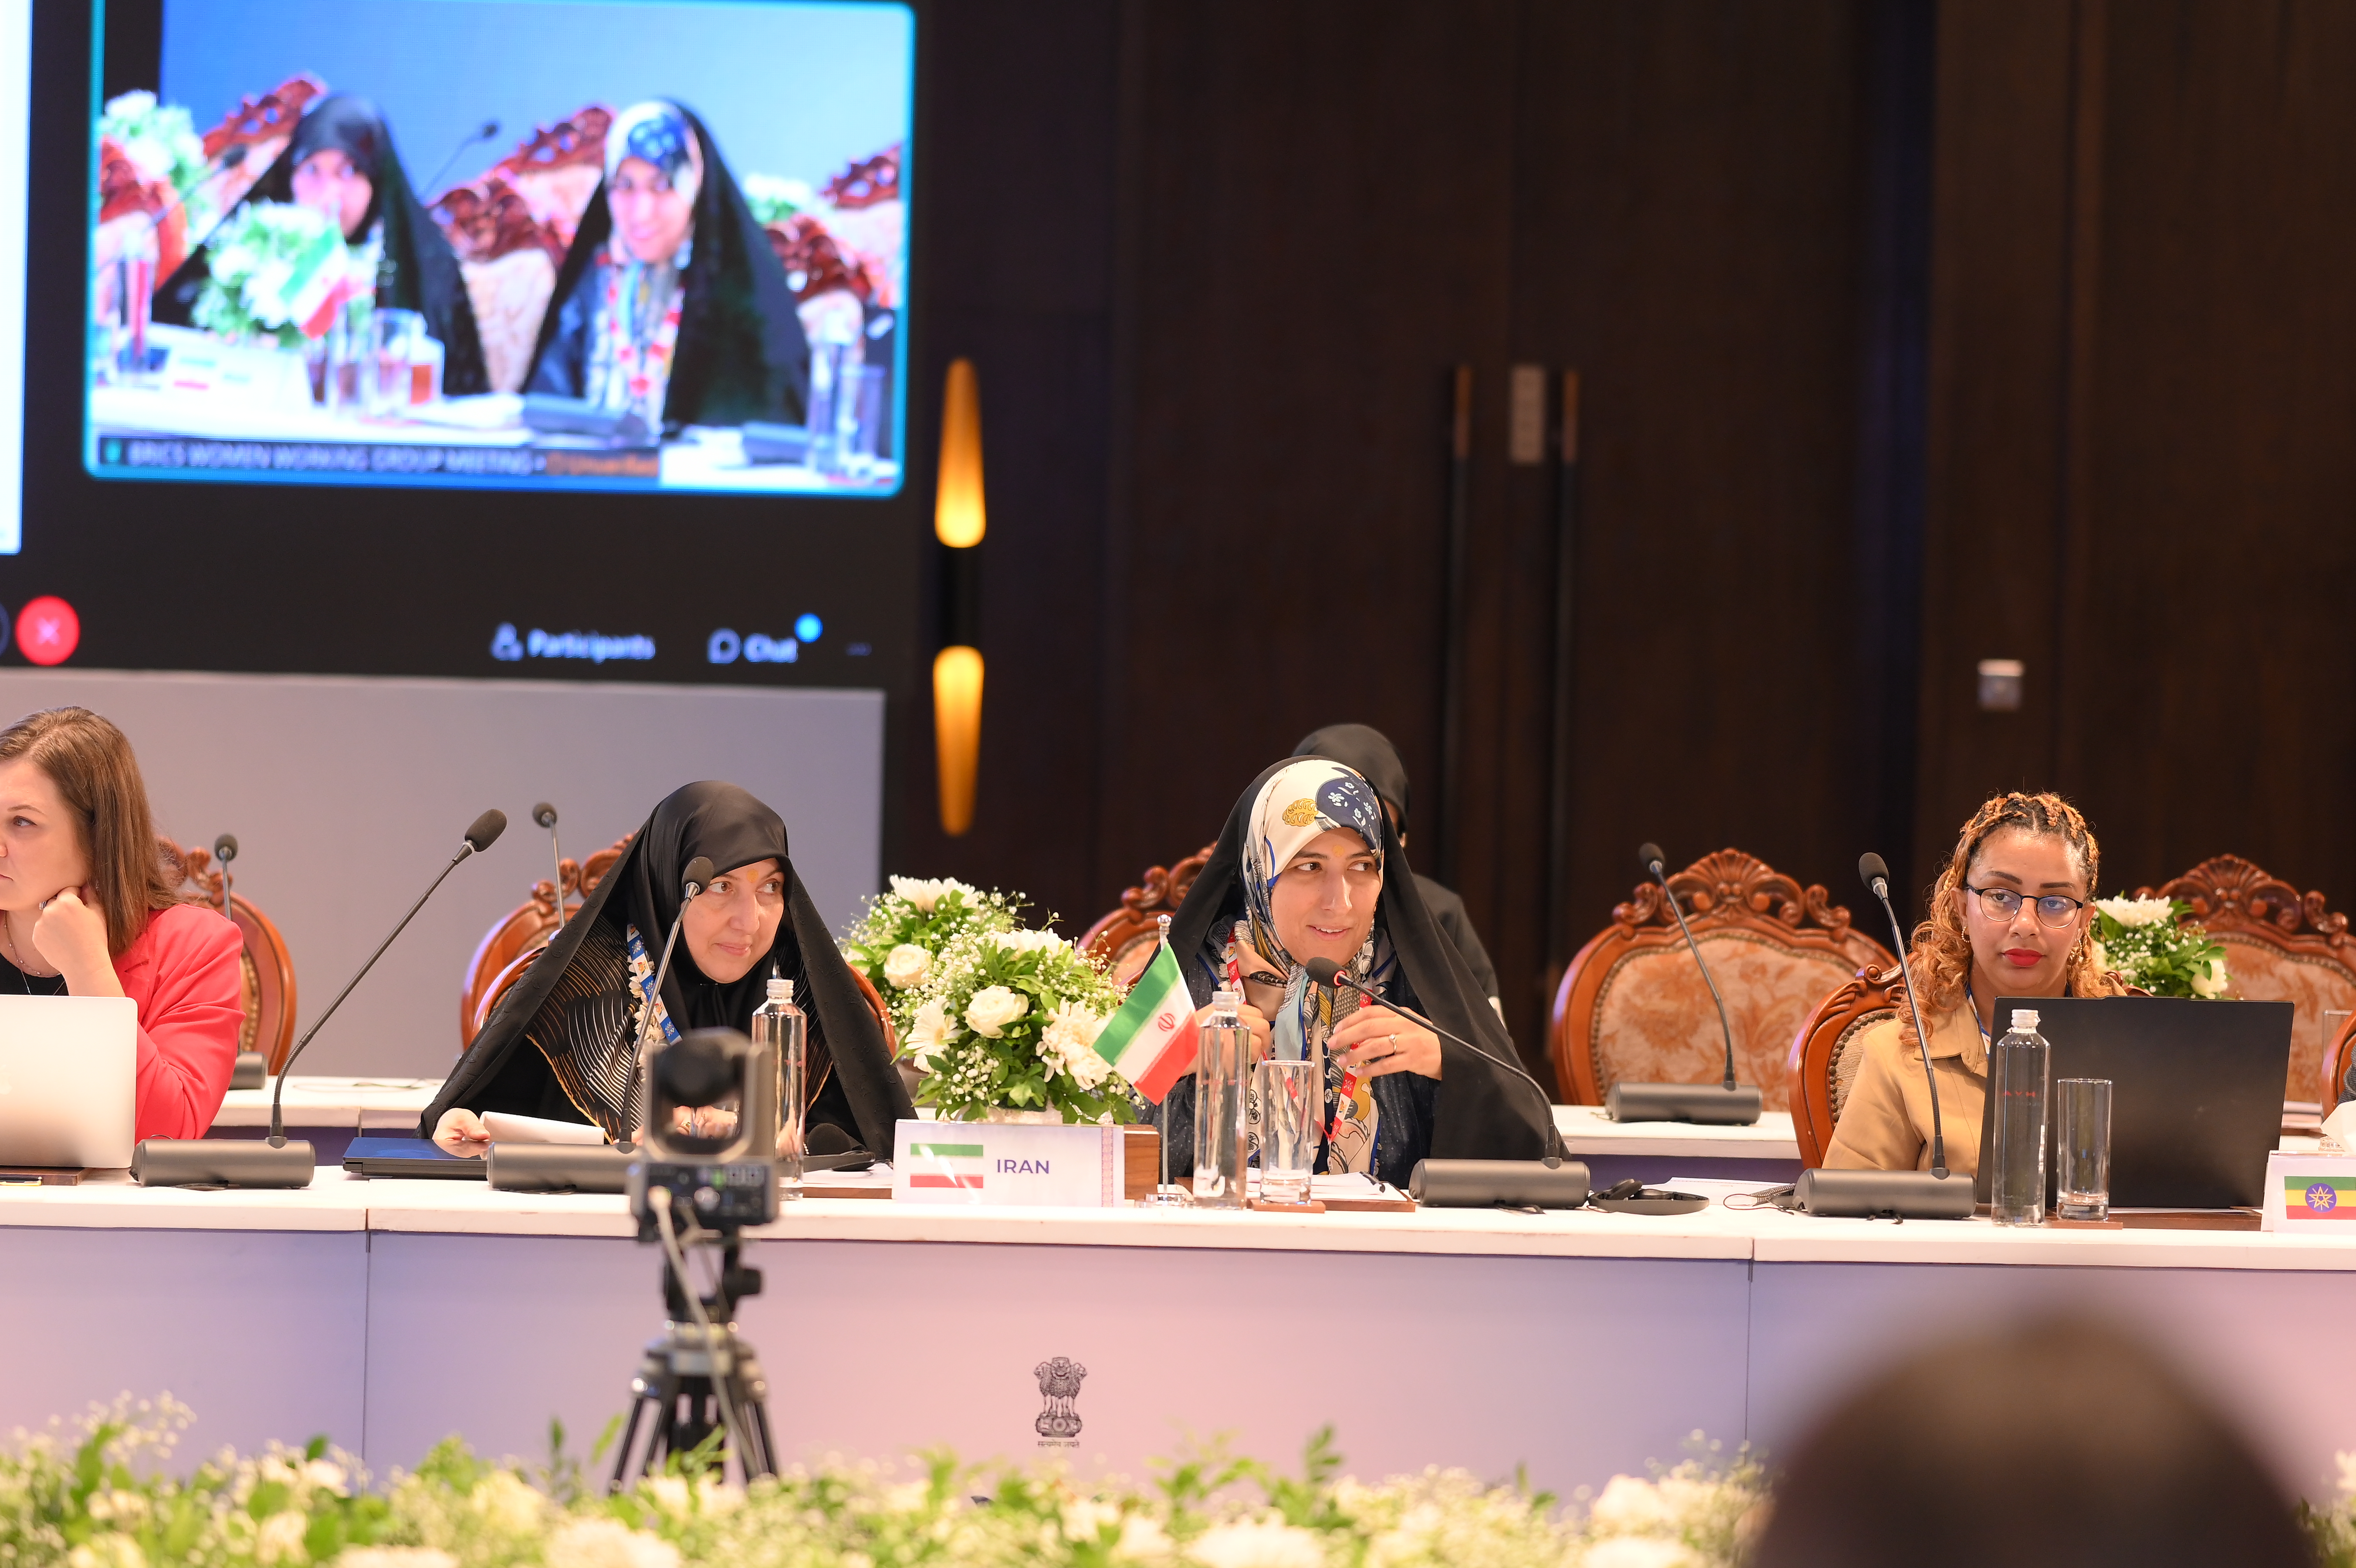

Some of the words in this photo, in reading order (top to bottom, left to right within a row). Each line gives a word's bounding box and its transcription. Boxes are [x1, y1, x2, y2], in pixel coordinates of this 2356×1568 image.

[187, 441, 271, 468] WOMEN
[273, 443, 369, 470] WORKING
[445, 448, 533, 475] MEETING
[528, 629, 655, 663] Participants
[743, 632, 798, 662] Chat
[997, 1159, 1049, 1174] IRAN
